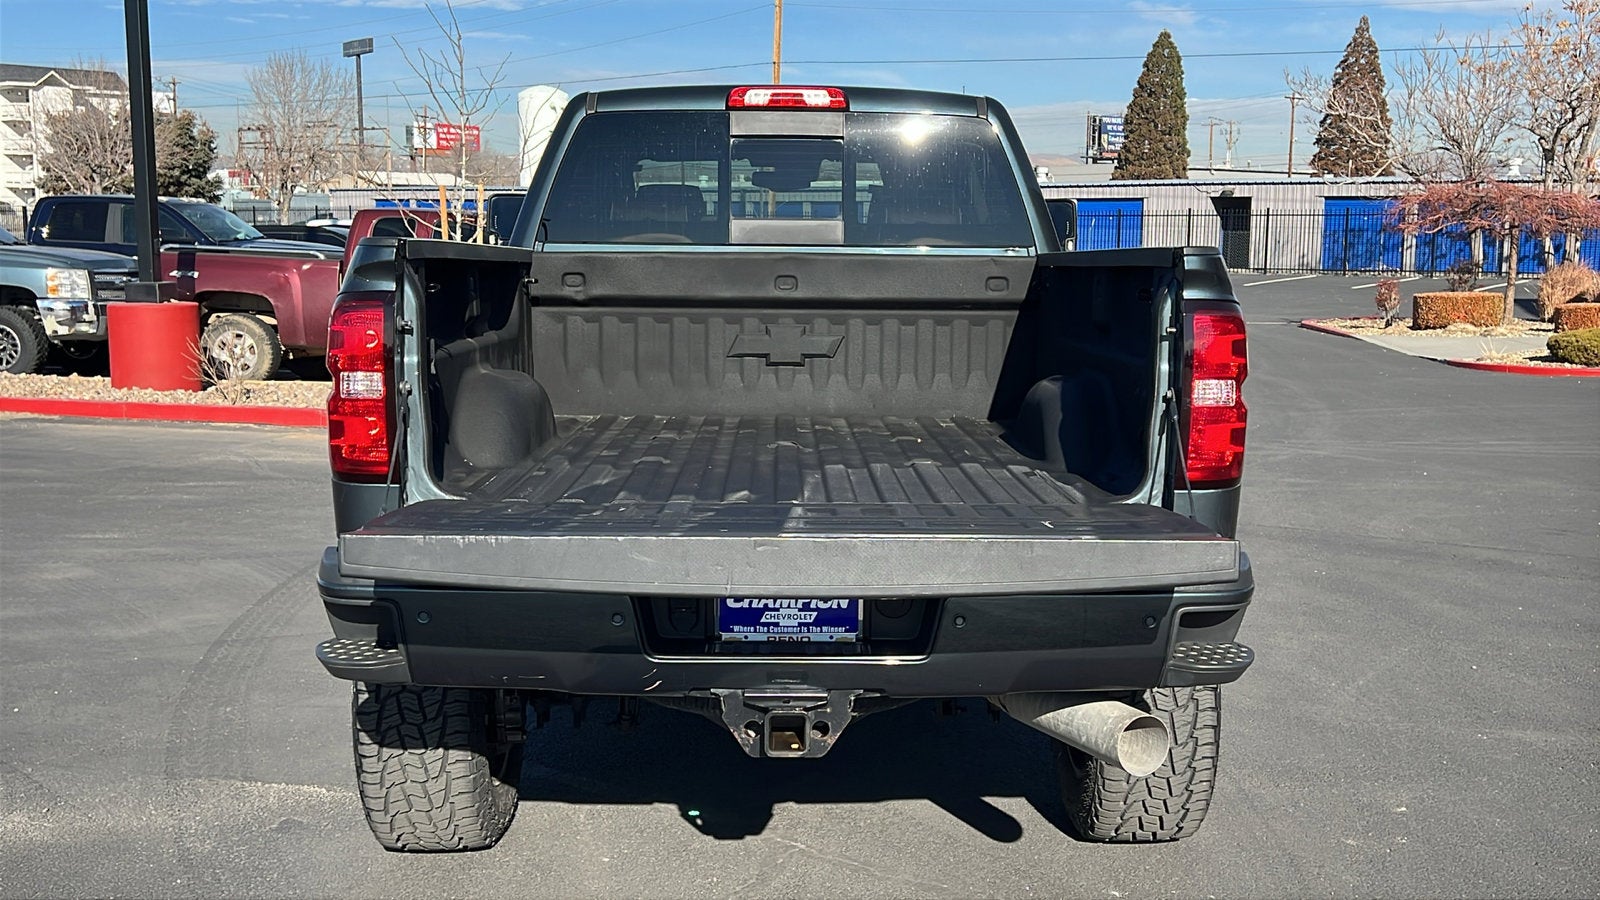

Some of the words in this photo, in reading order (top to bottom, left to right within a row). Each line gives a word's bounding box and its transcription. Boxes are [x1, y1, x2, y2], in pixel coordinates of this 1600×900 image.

[764, 613, 814, 621] CHEVROLET
[756, 625, 767, 633] The
[769, 625, 800, 633] Customer
[801, 625, 808, 633] Is
[809, 625, 821, 633] The
